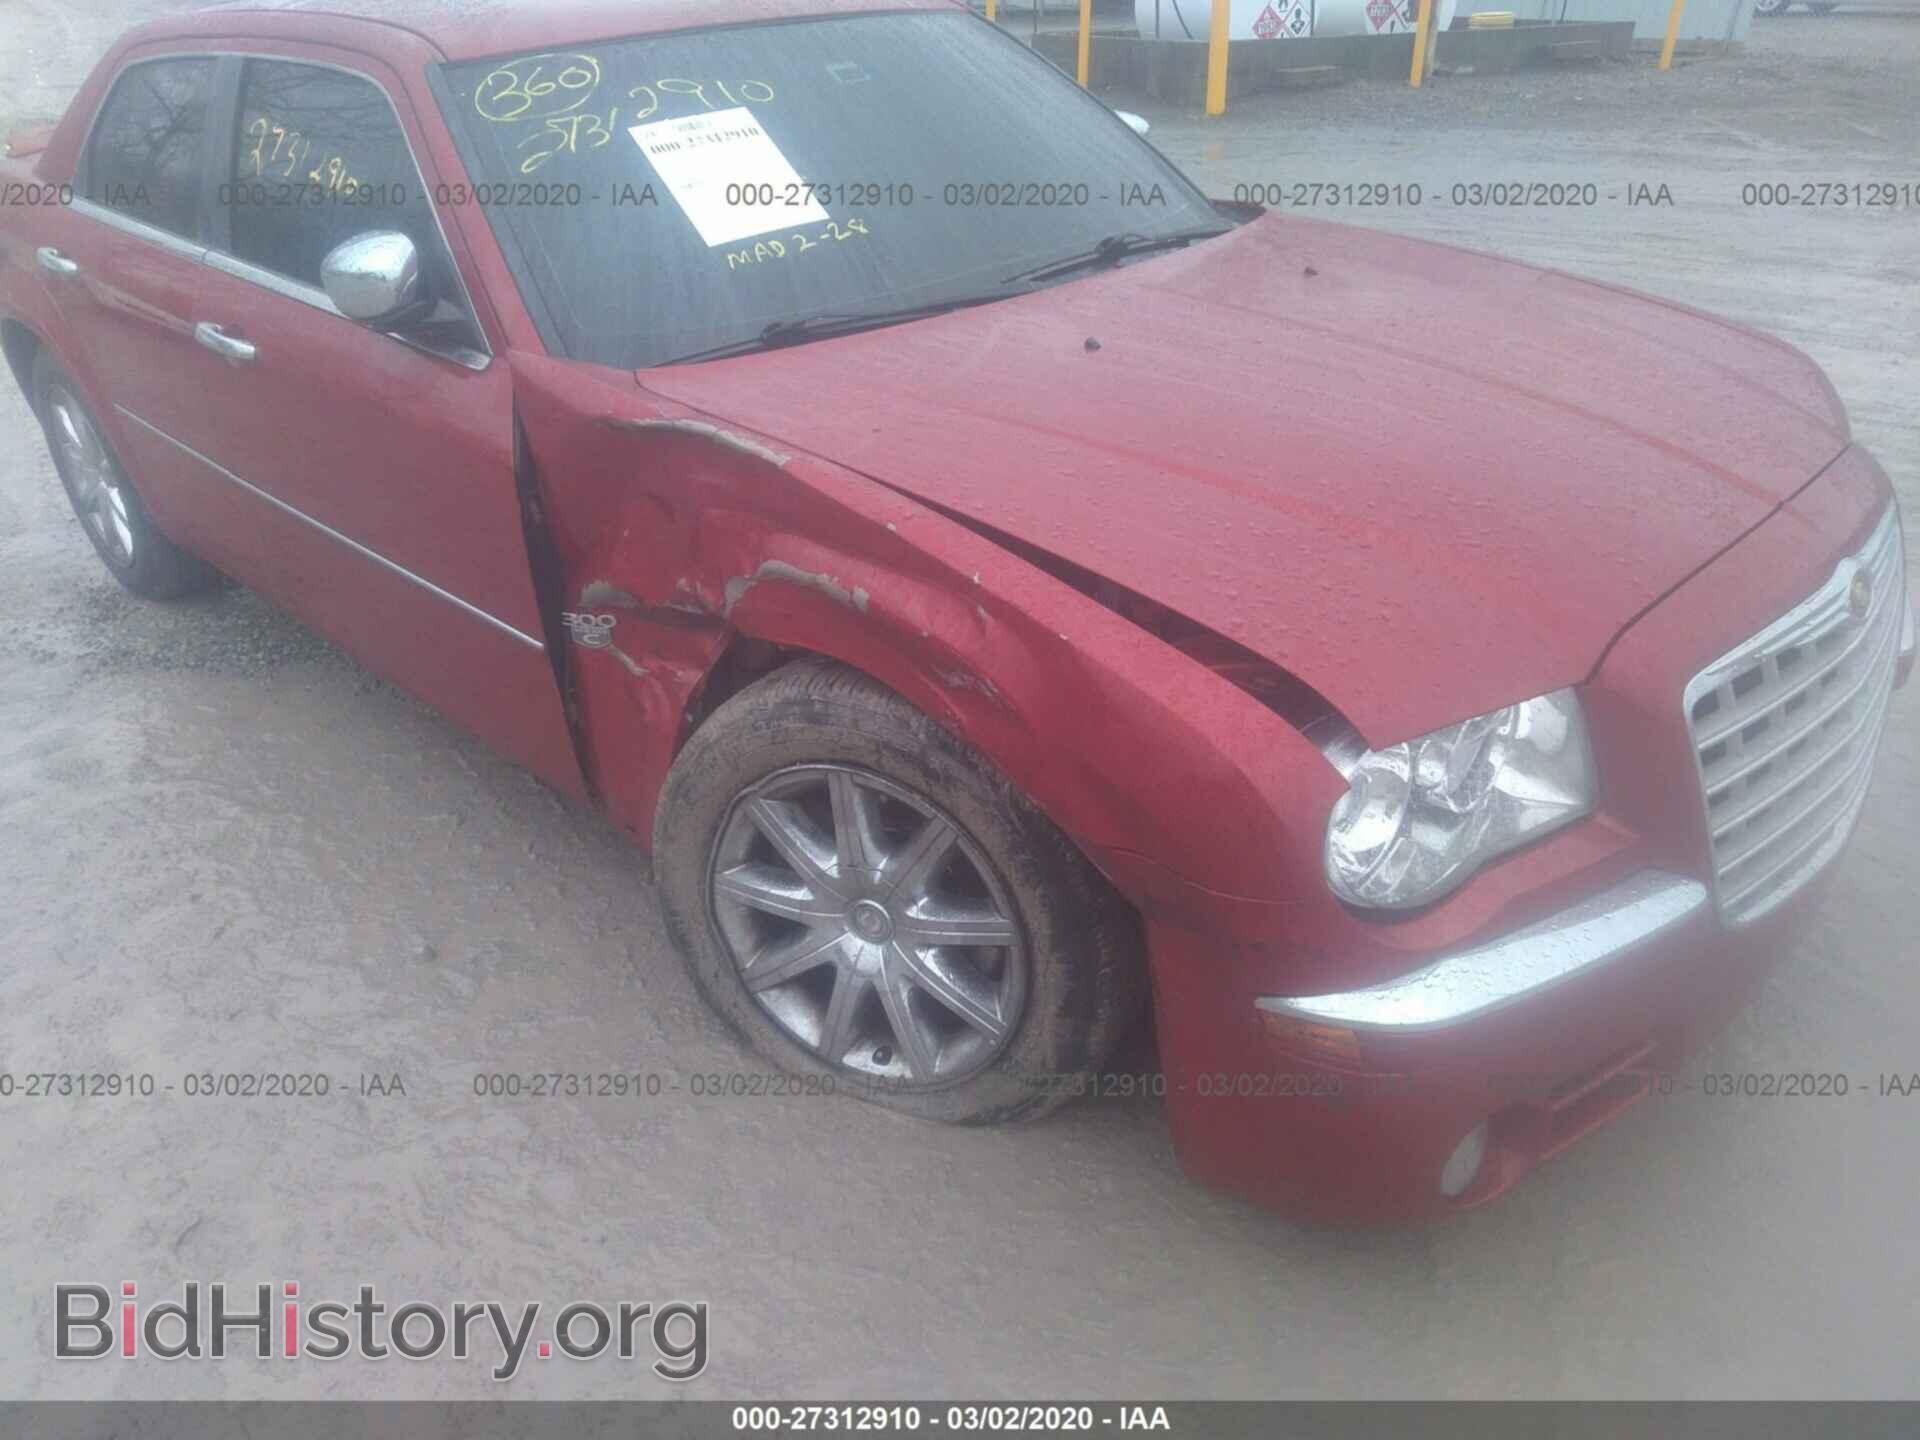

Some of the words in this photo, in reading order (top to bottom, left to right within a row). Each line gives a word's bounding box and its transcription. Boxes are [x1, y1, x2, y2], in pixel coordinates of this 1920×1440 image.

[487, 66, 593, 121] 360
[629, 78, 775, 119] 2910
[727, 240, 786, 270] MAD
